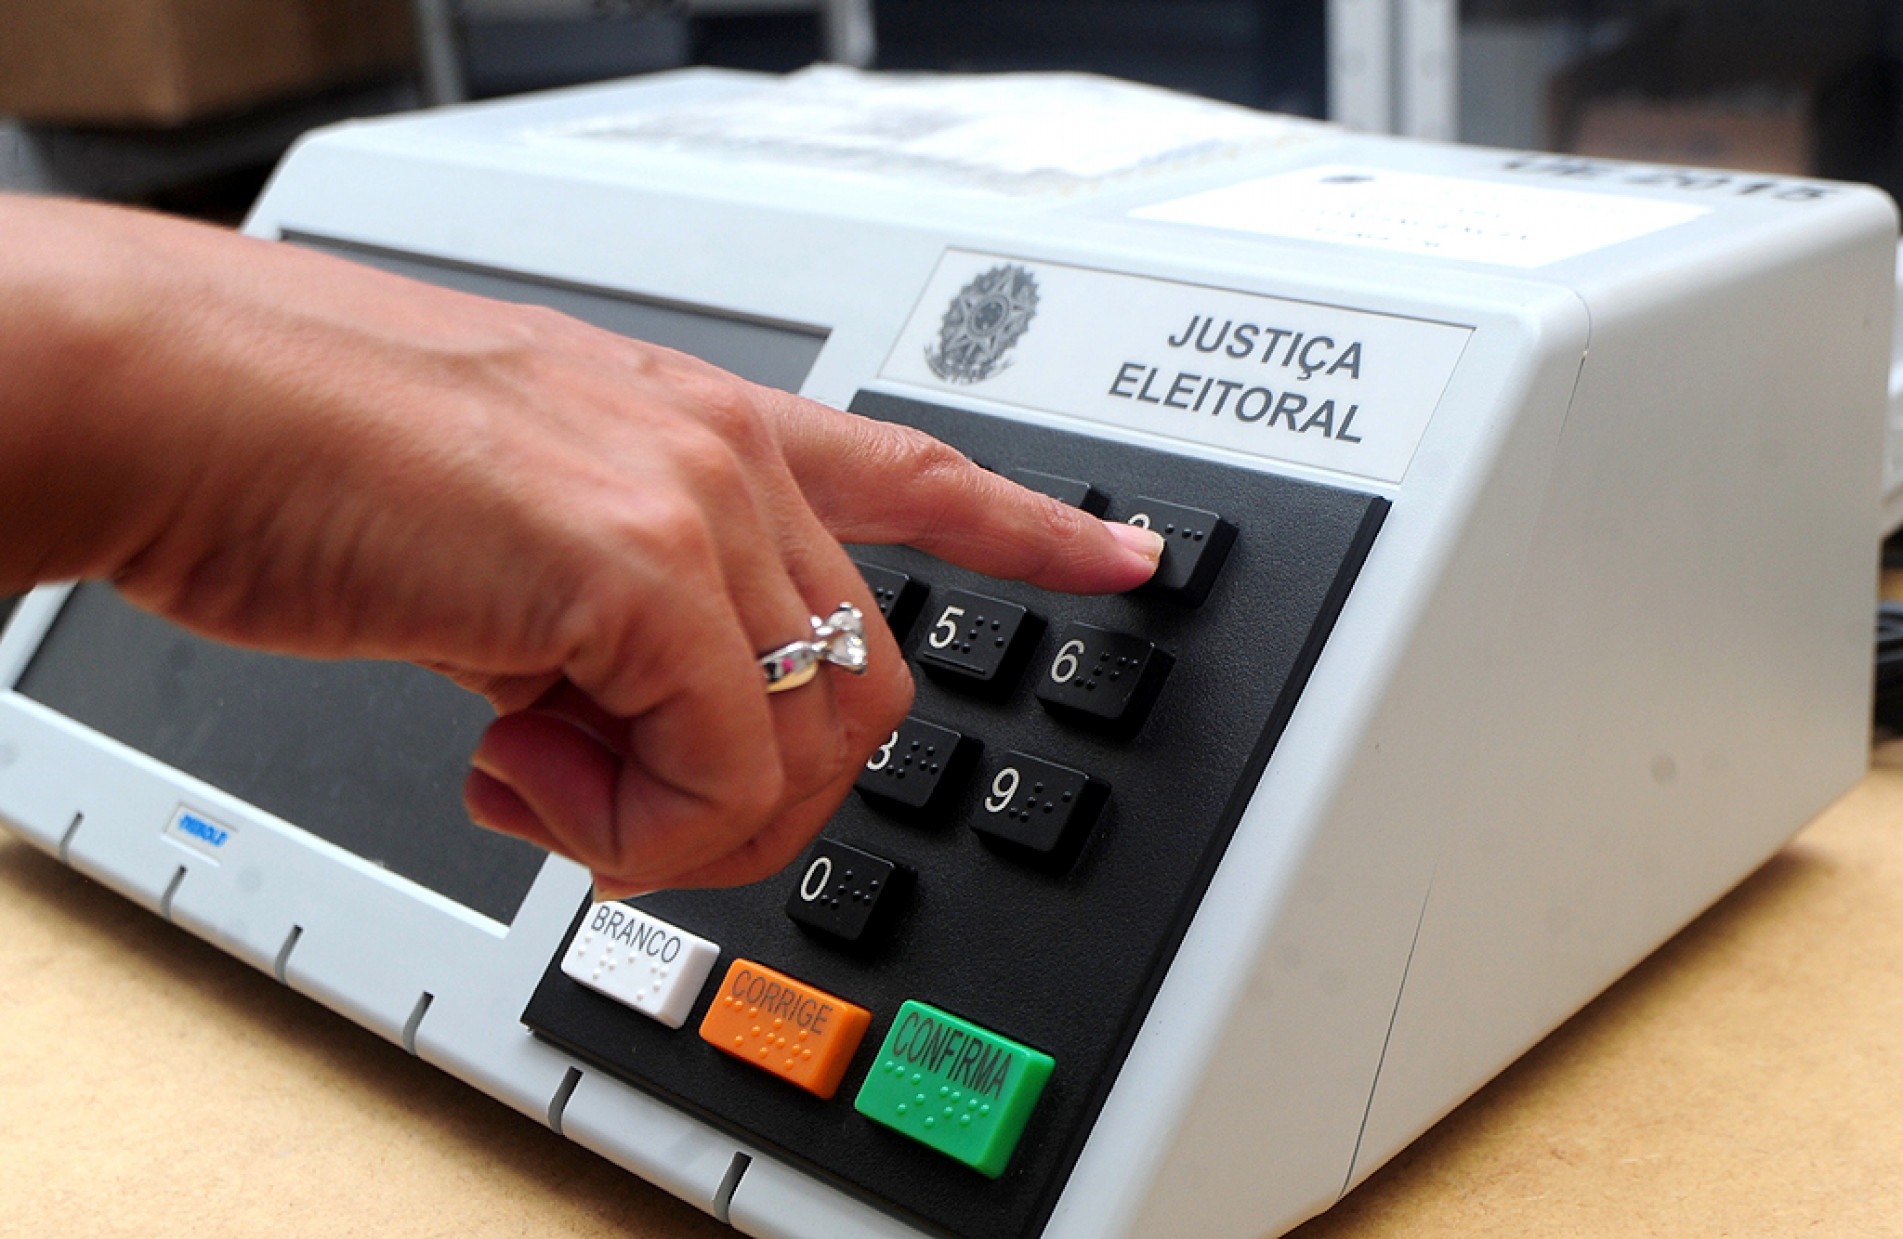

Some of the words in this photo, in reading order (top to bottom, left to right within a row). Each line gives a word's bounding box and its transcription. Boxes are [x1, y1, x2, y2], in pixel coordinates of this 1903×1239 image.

[1167, 315, 1363, 381] JUSTIÇA
[1108, 361, 1363, 444] ELEITORAL
[929, 606, 965, 649] 5
[1050, 639, 1085, 684] 6
[985, 767, 1021, 813] 9
[800, 856, 833, 902] 0
[590, 905, 682, 964] BRANCO
[731, 969, 834, 1035] CORRIGE
[892, 1010, 1013, 1098] CONFIRMA
